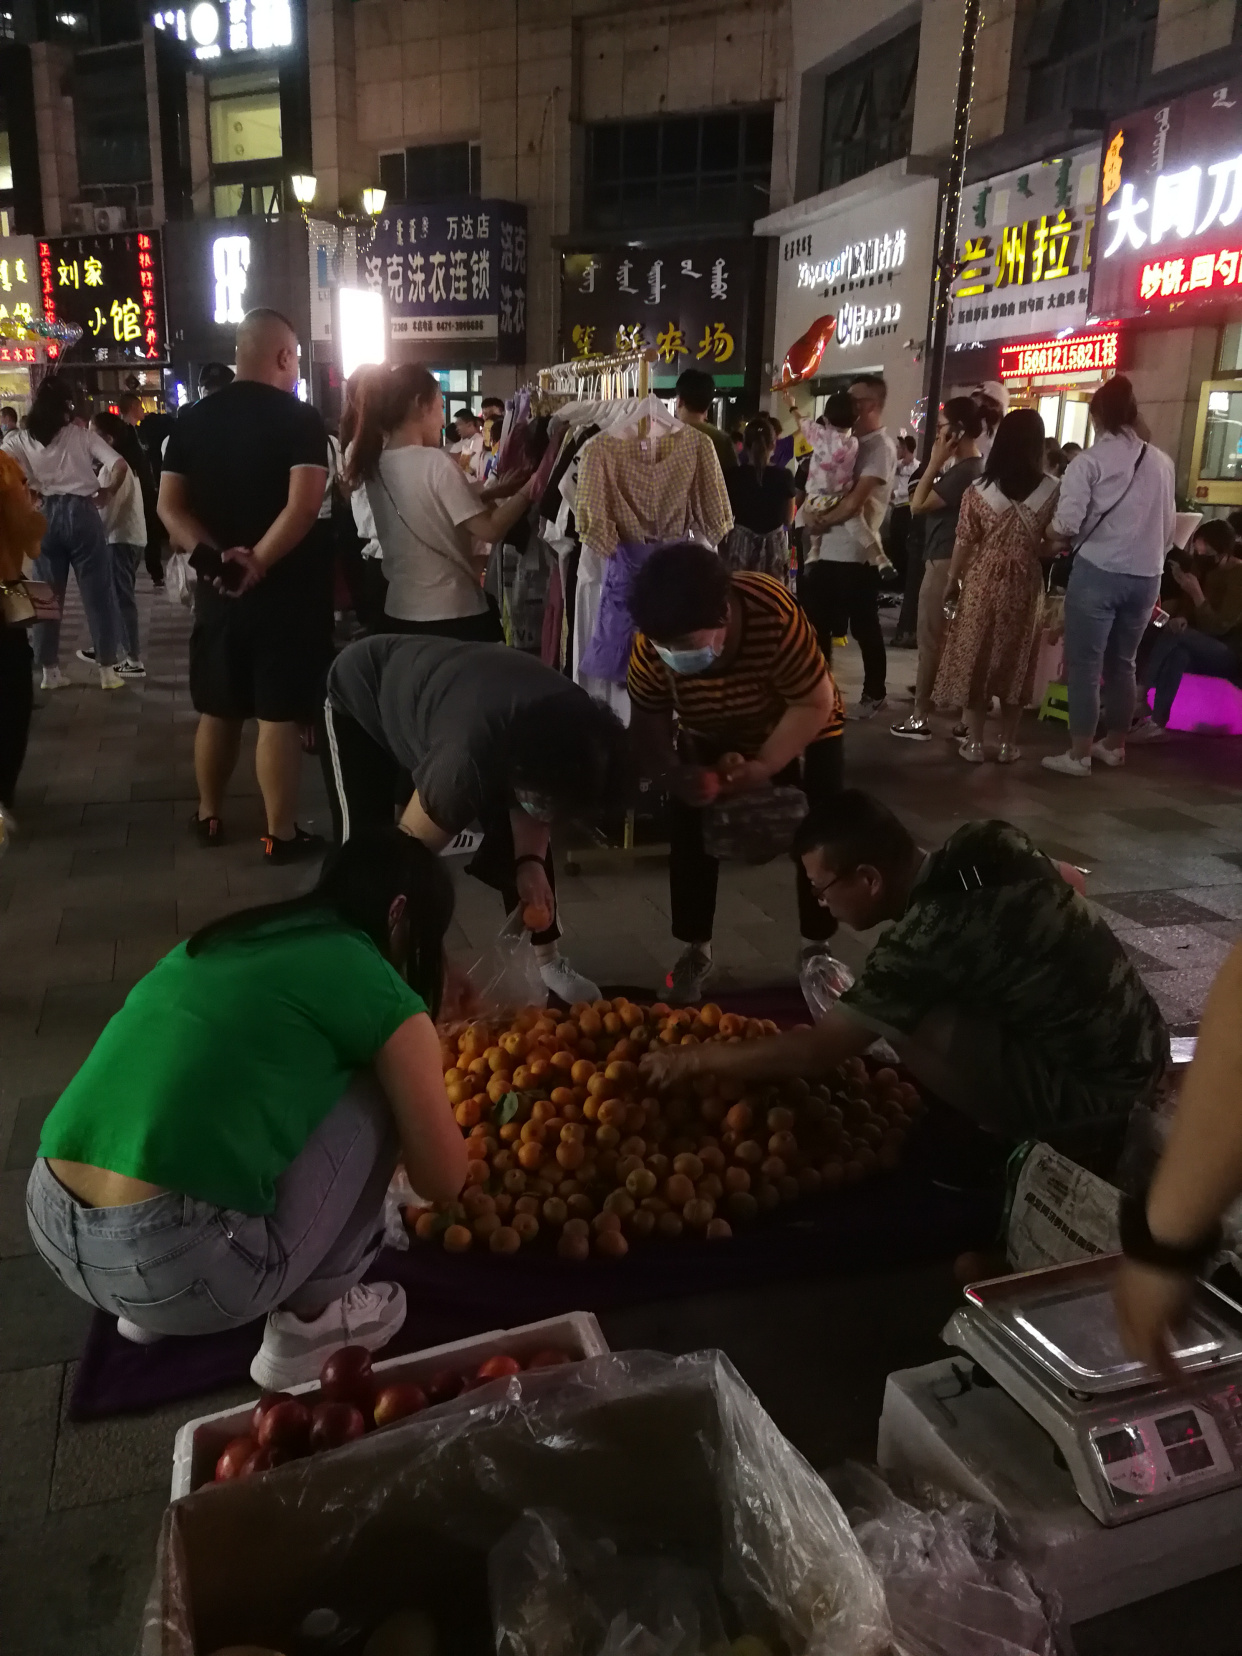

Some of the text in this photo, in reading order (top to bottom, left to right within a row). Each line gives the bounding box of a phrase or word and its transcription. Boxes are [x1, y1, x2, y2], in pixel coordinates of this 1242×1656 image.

[446, 213, 491, 241] 万达店
[57, 255, 104, 289] 刘家
[364, 247, 490, 304] 洛克洗衣连锁
[1140, 249, 1242, 300] 炒饼,回勺
[88, 297, 142, 342] 小馆
